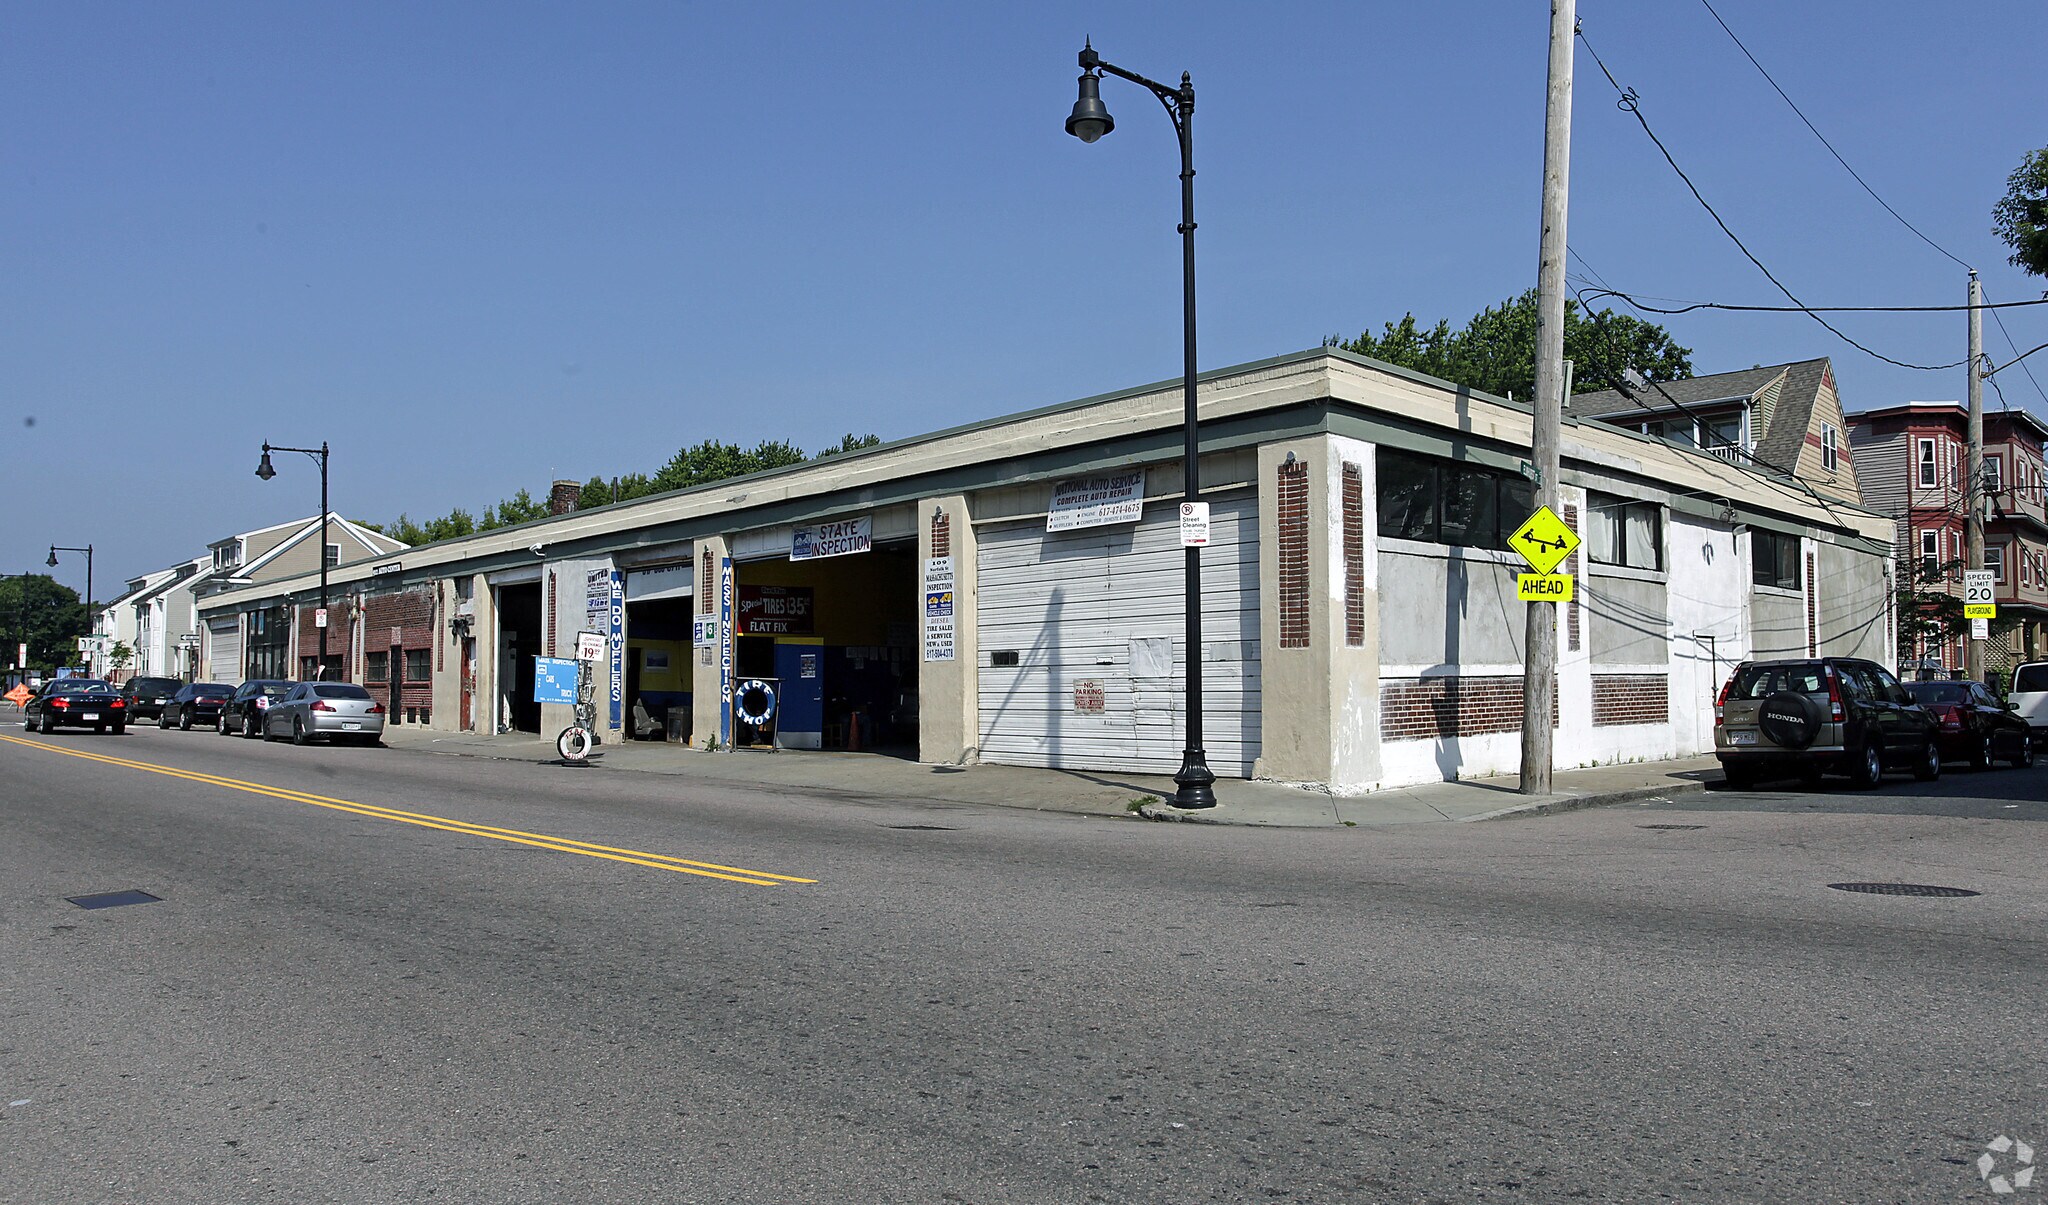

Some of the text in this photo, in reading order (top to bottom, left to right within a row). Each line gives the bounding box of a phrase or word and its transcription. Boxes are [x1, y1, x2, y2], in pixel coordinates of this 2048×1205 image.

[1055, 472, 1141, 497] NATIONAL AUTO SERVICE
[1056, 494, 1089, 505] COMPLETE
[1090, 491, 1108, 501] AUTO
[1109, 487, 1132, 498] REPAIR
[1098, 503, 1140, 517] 617-474-4675
[819, 521, 859, 540] STATE
[811, 534, 871, 557] INSPECTION
[588, 568, 608, 584] UNITED
[610, 580, 624, 598] WE
[722, 566, 732, 606] MASS
[926, 582, 953, 592] INSPECTION
[1521, 580, 1564, 594] AHEAD
[1968, 588, 1992, 600] 20
[763, 598, 785, 614] TIRES
[1967, 606, 1992, 614] PLAYGROUND
[611, 606, 622, 626] DO
[750, 621, 788, 632] FLAT FIX
[722, 612, 731, 703] INSPECTION
[610, 633, 624, 702] MUFFLERS
[736, 680, 774, 696] TIRE
[736, 707, 770, 724] SHOP
[1767, 712, 1805, 724] HONDA
